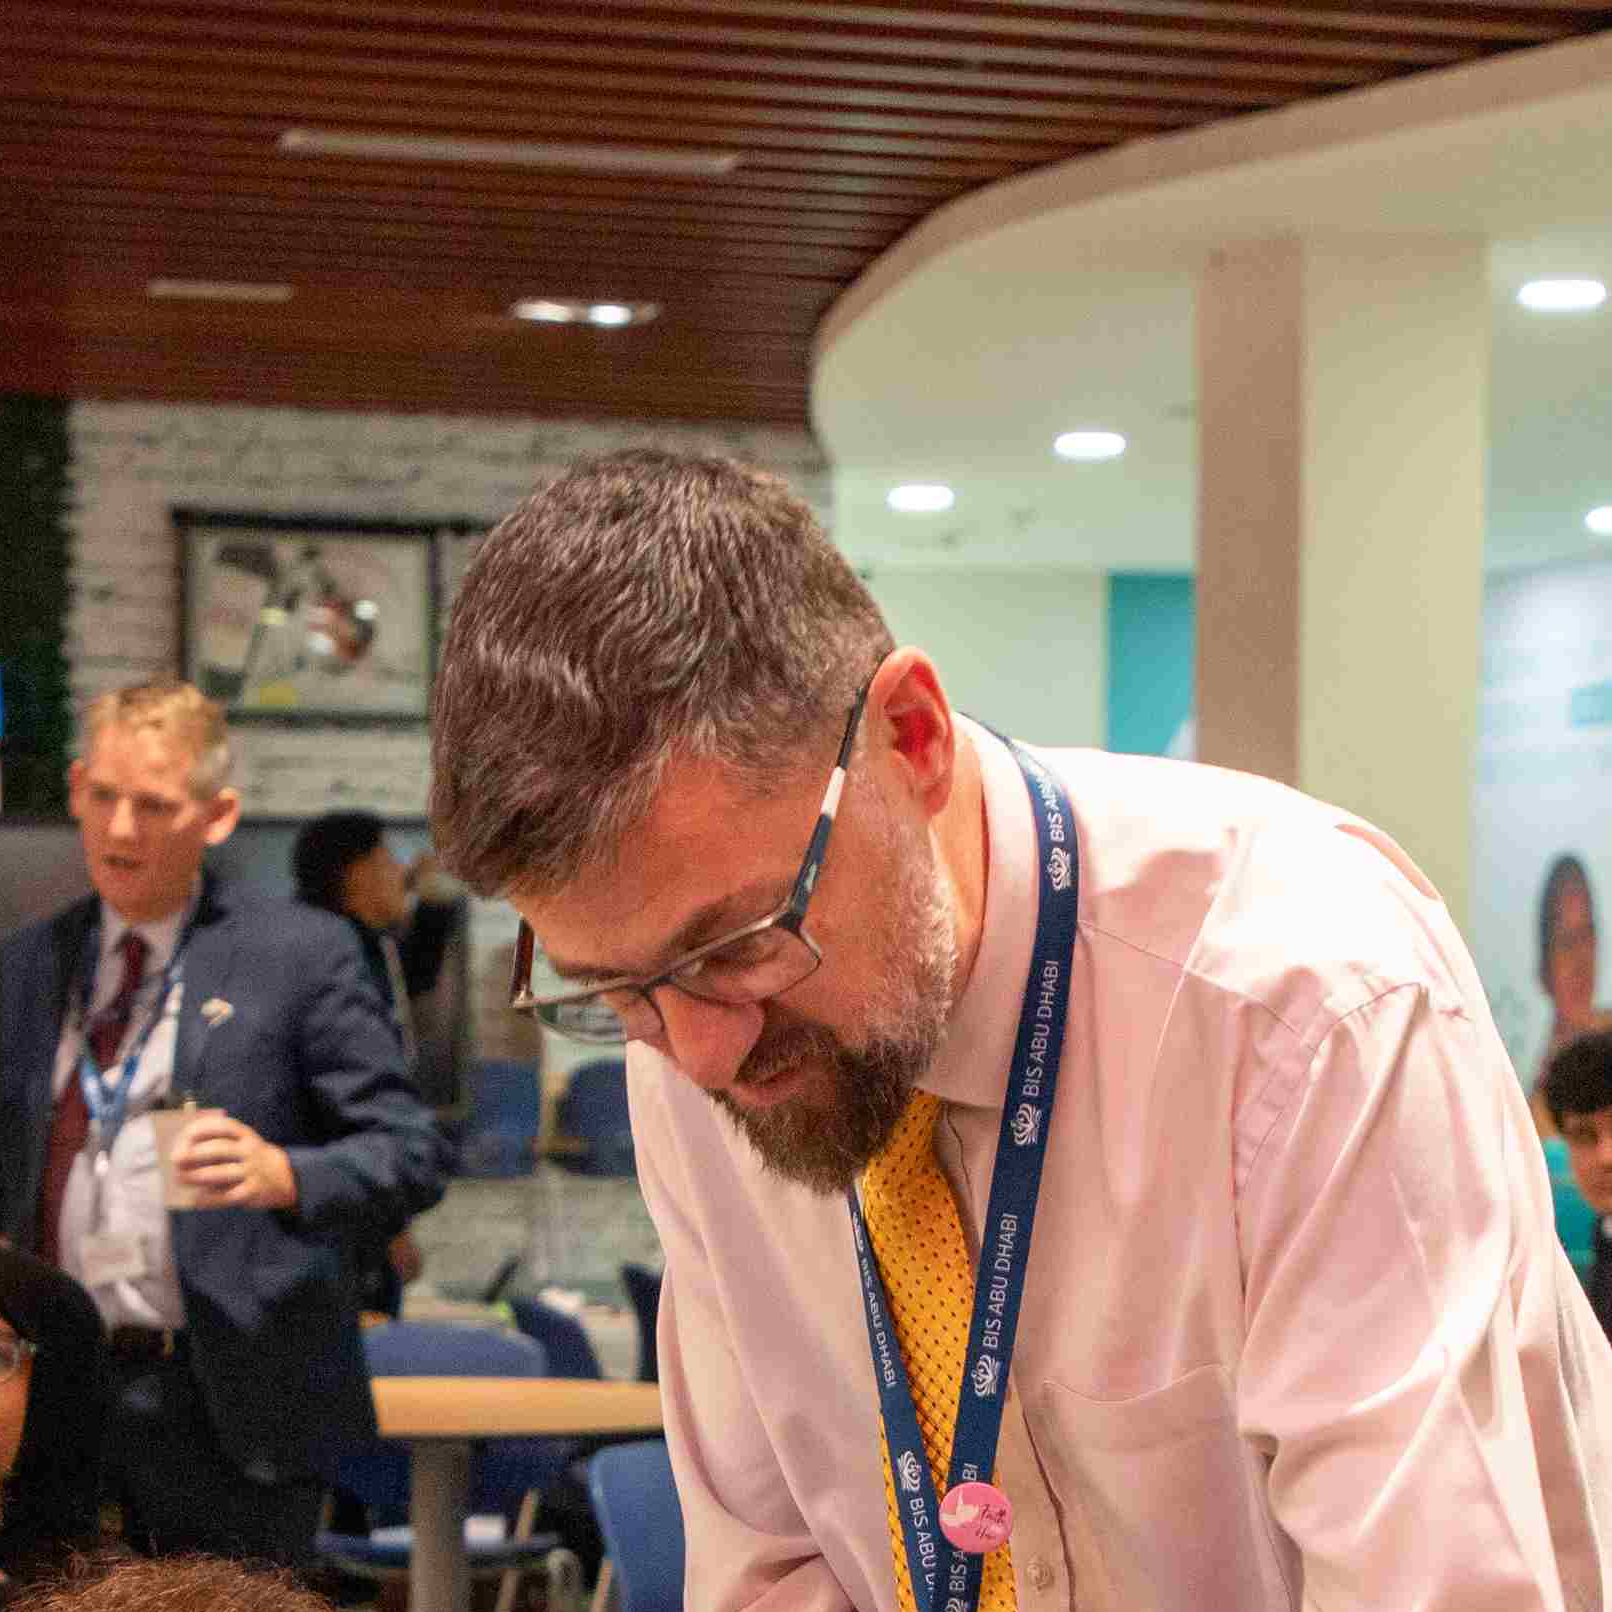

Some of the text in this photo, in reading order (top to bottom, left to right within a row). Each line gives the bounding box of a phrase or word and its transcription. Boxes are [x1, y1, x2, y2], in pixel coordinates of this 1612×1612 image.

[1048, 812, 1065, 842] BIS
[1022, 960, 1060, 1097] BIS ABU DHABI
[982, 1212, 1019, 1349] BIS ABU DHABI
[868, 1292, 884, 1329] ABU
[874, 1331, 899, 1388] DHABI
[909, 1498, 929, 1528] BIS
[916, 1530, 938, 1569] ABU
[949, 1564, 967, 1591] BIS
